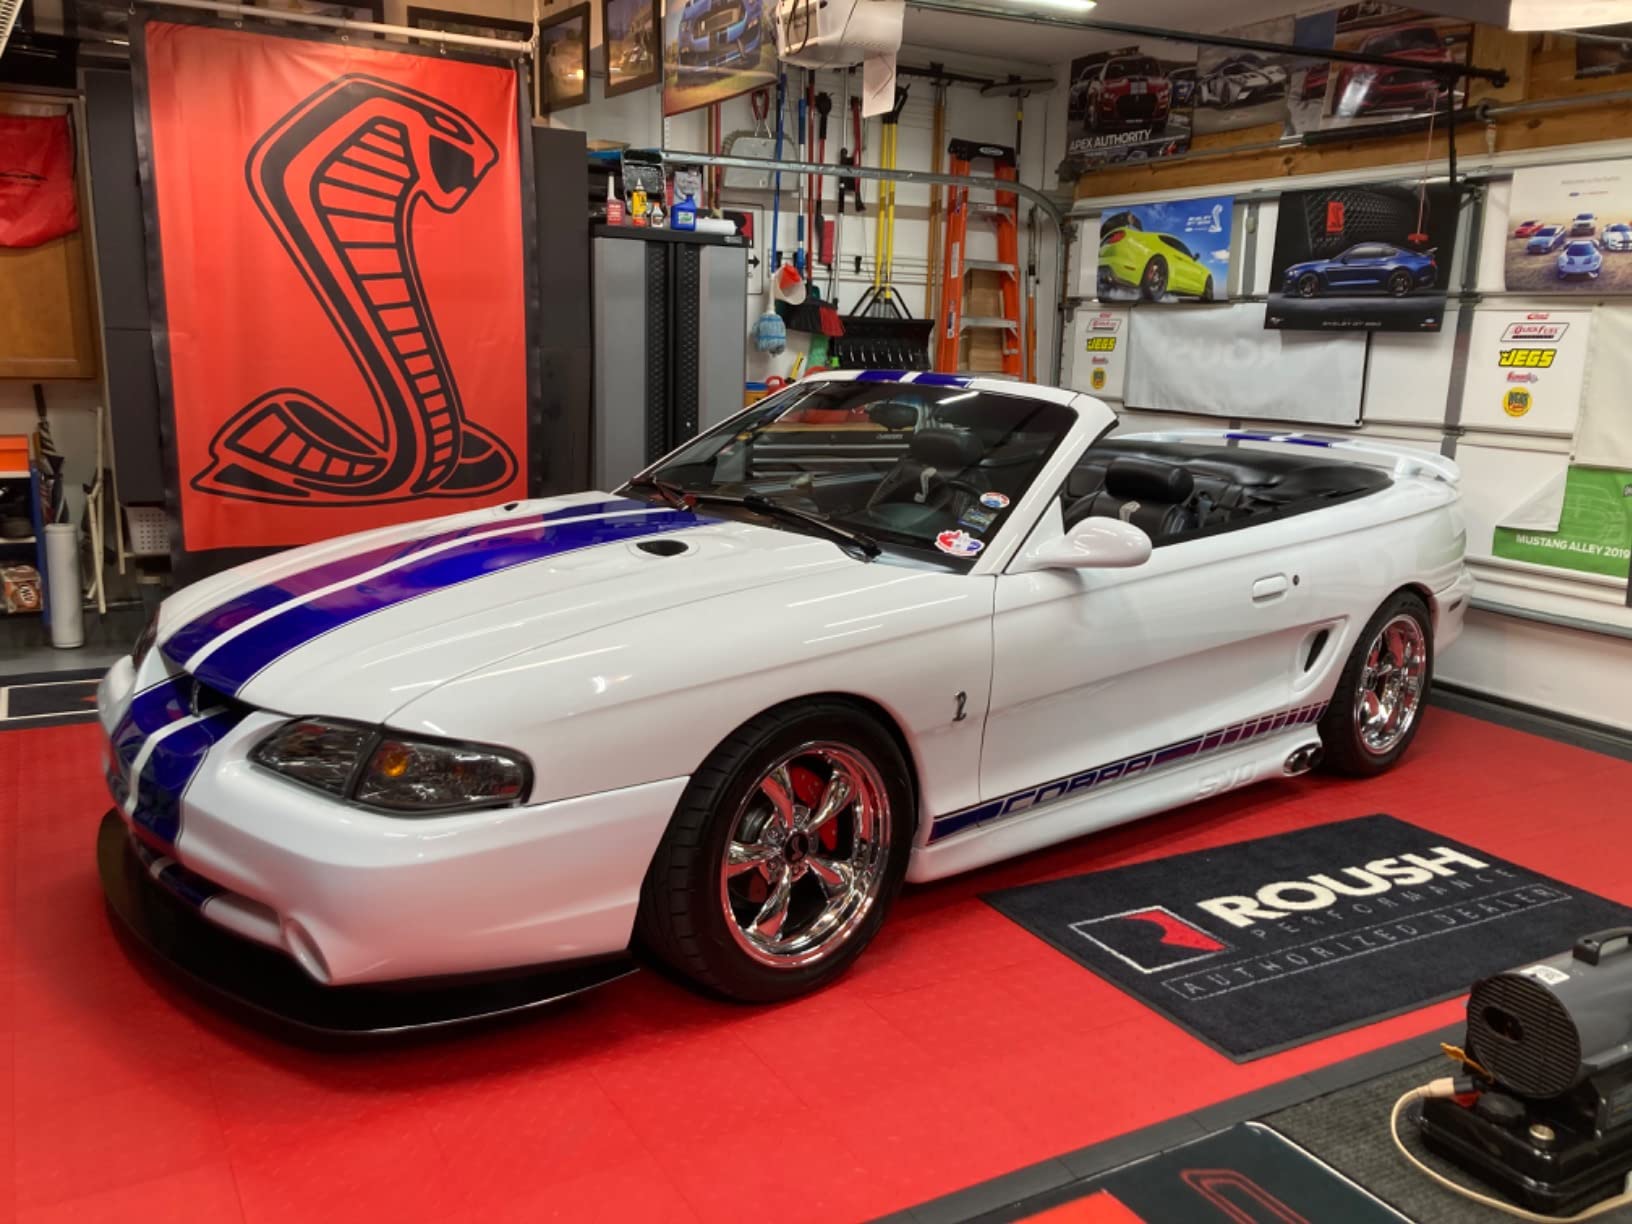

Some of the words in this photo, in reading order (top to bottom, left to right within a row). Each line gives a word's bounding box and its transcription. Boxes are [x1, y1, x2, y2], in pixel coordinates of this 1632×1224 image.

[1069, 138, 1094, 152] APEX
[1093, 128, 1152, 148] AUTHORITY
[1086, 337, 1117, 352] JEGS
[1499, 349, 1557, 368] JEGS
[1516, 533, 1568, 550] MUSTANG
[1568, 540, 1604, 556] ALLEY
[1603, 545, 1631, 559] 2019
[1197, 846, 1490, 929] ROUSH
[1253, 869, 1515, 939] PERFORMANCE
[1184, 916, 1419, 994] AUTHORIZED
[1431, 886, 1555, 927] DEALER
